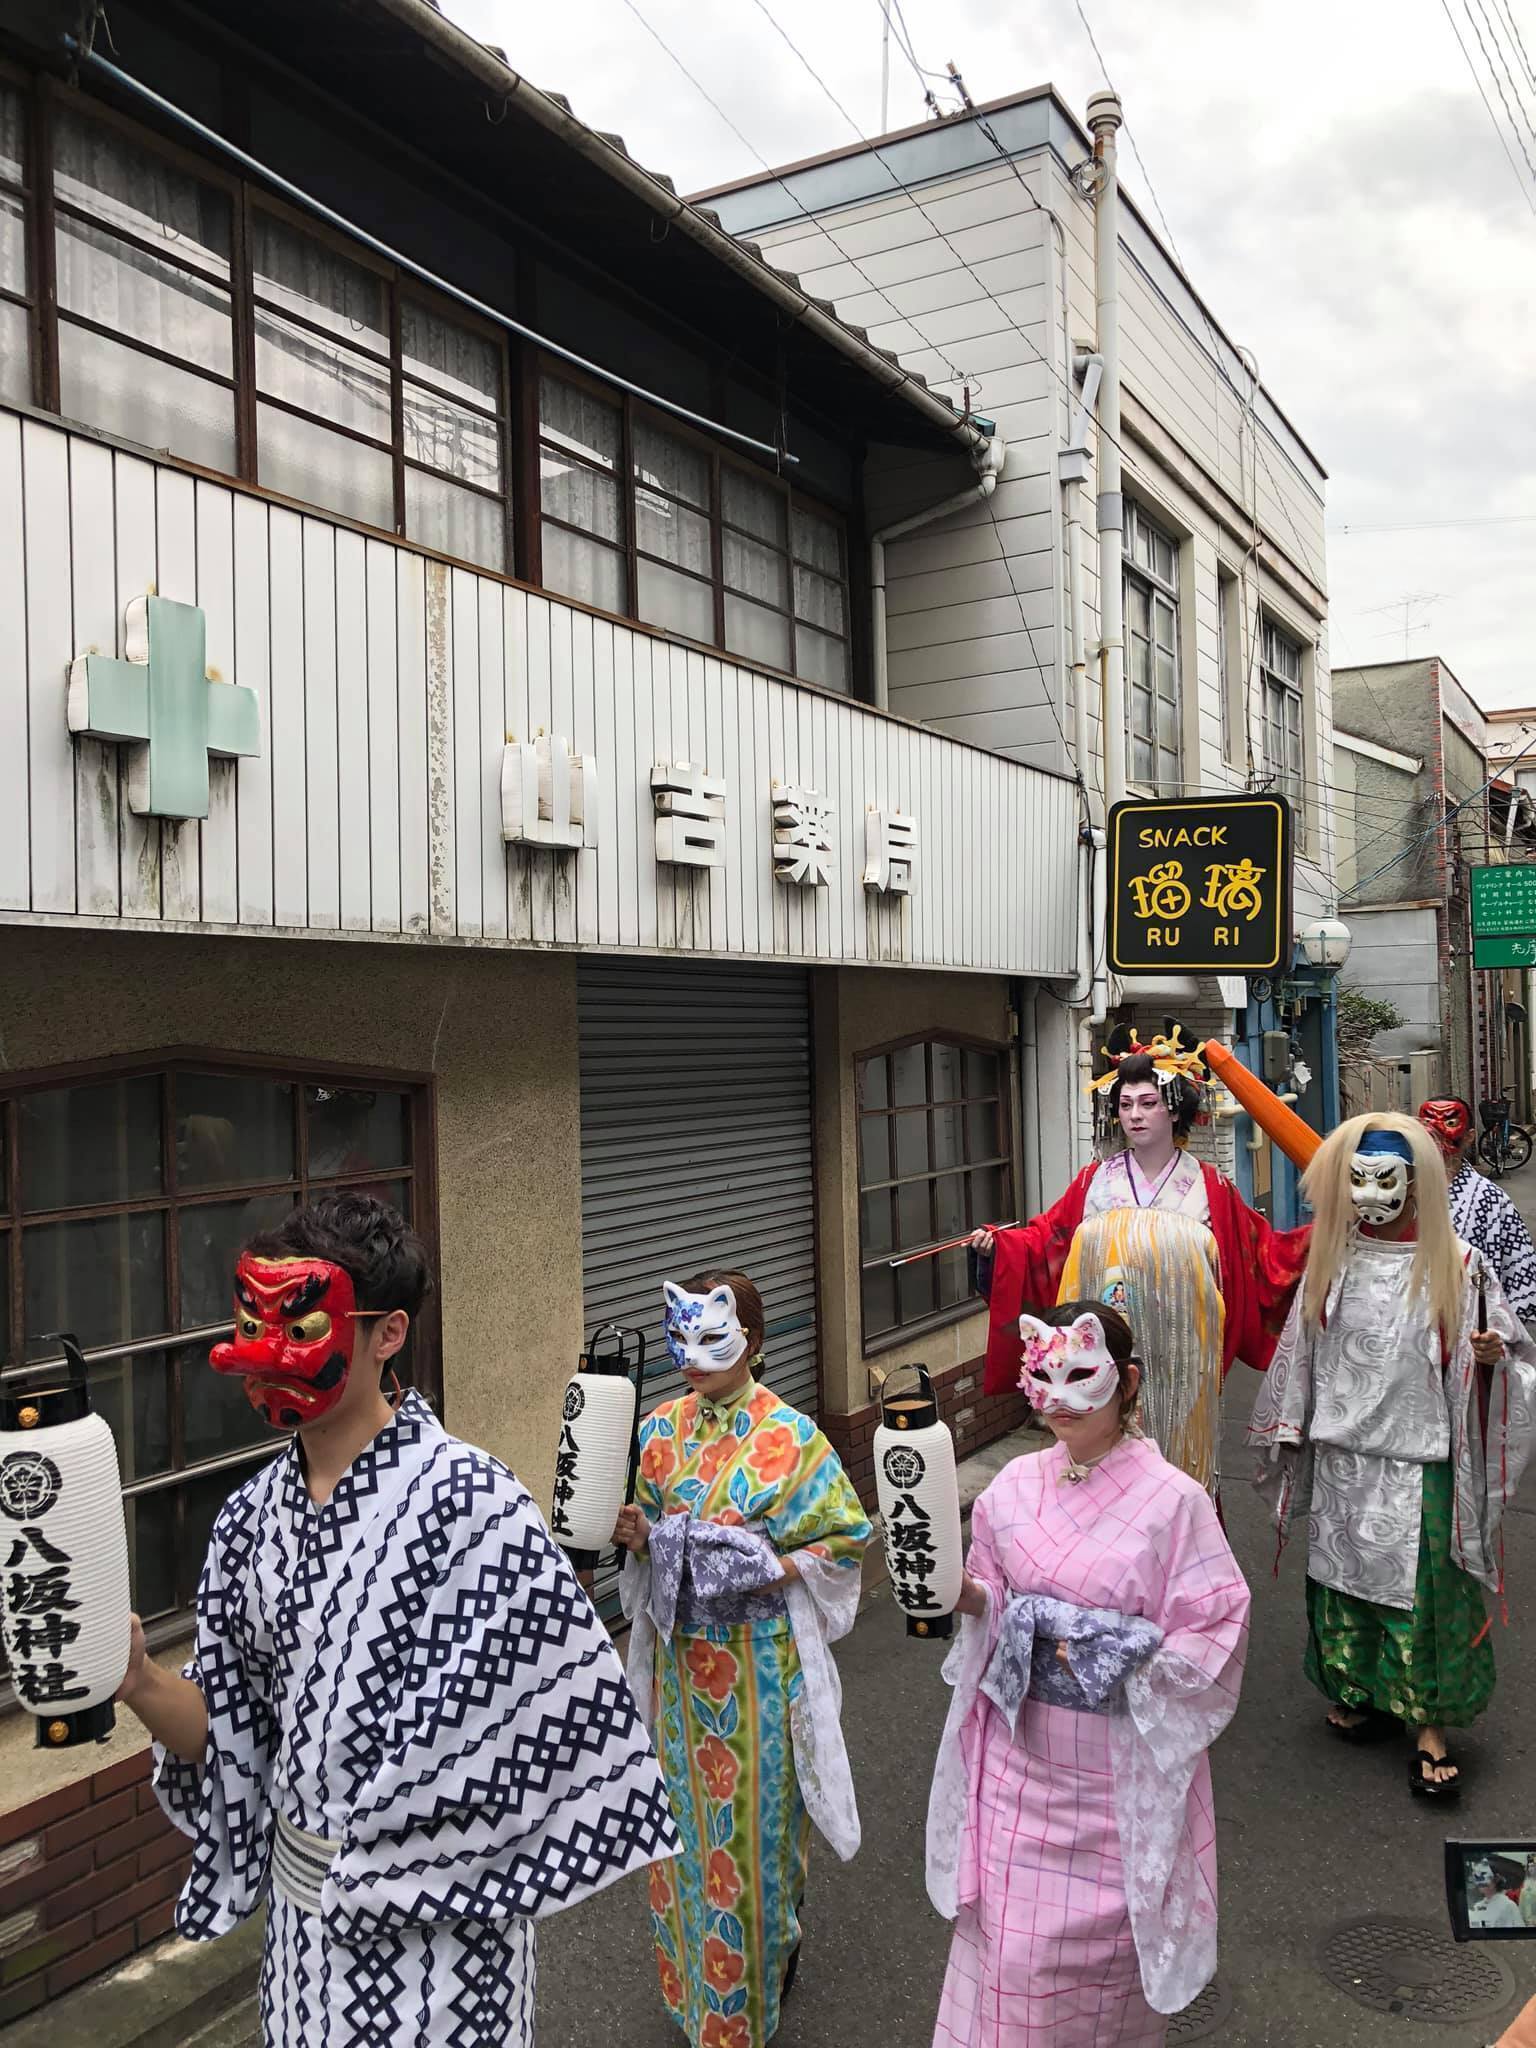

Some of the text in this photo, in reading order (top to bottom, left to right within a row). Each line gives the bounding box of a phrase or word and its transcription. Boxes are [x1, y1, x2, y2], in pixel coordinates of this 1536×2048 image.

[501, 733, 918, 897] 山吉薬局
[1138, 825, 1228, 849] SNACK
[1146, 926, 1240, 947] RU RI
[888, 1493, 943, 1611] 八坂神社
[3, 1526, 91, 1705] 八坂神社
